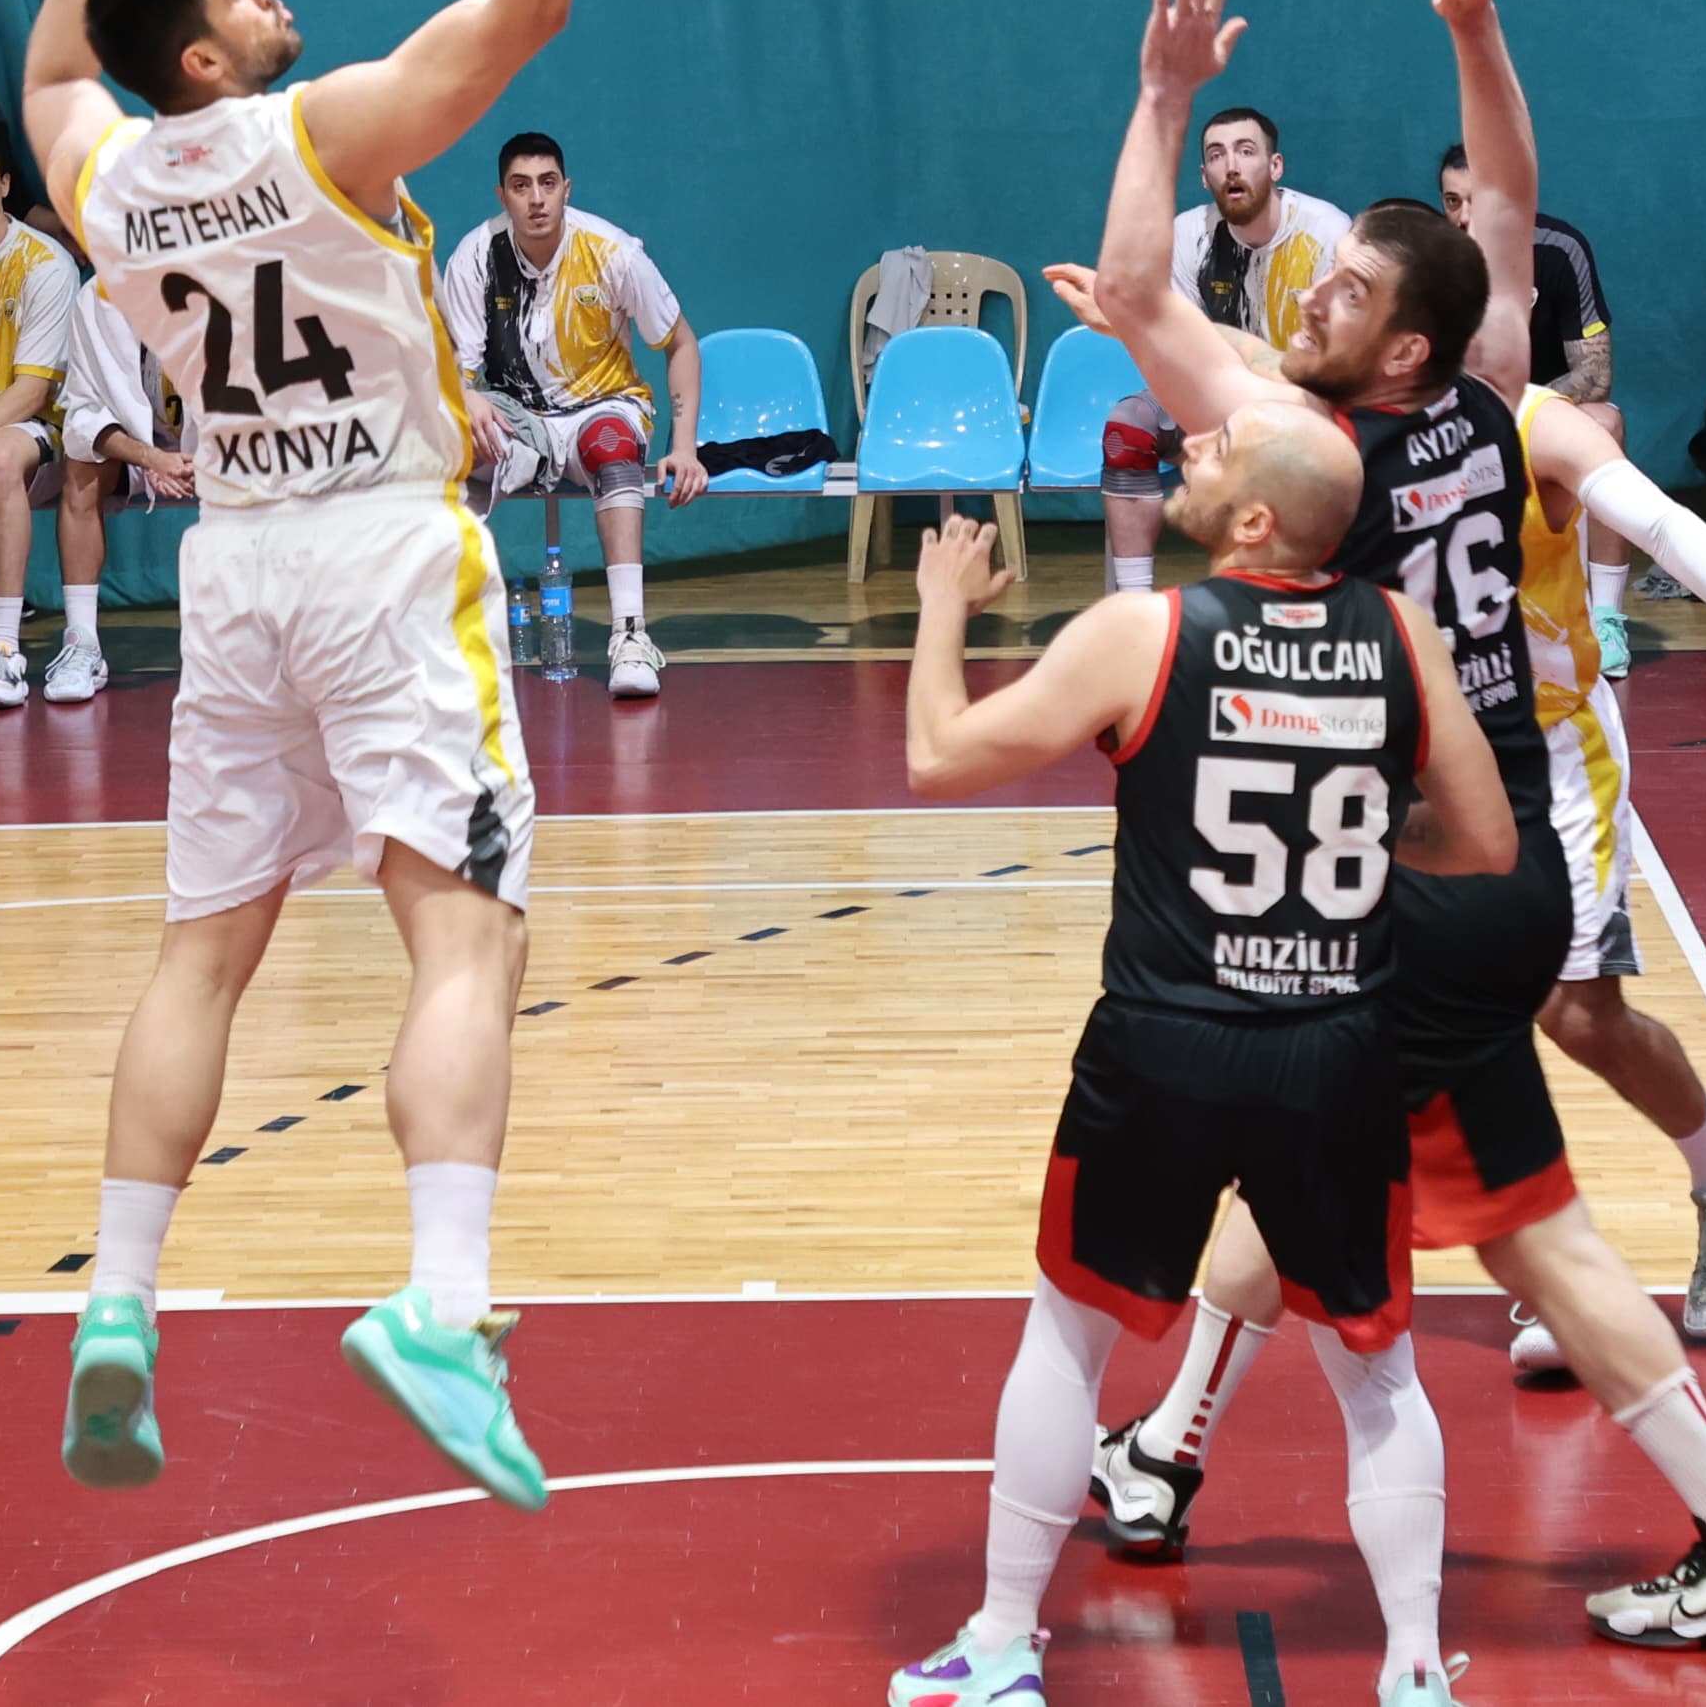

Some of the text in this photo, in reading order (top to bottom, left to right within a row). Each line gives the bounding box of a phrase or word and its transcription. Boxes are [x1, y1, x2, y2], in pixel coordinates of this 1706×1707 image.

[124, 180, 290, 255] METEHAN
[160, 259, 356, 417] 24
[214, 417, 380, 476] KONYA
[1214, 625, 1383, 681] OĞULCAN
[1260, 708, 1384, 735] DmgStone
[1189, 756, 1391, 921] 58
[1214, 930, 1358, 972] NAZİLLİ
